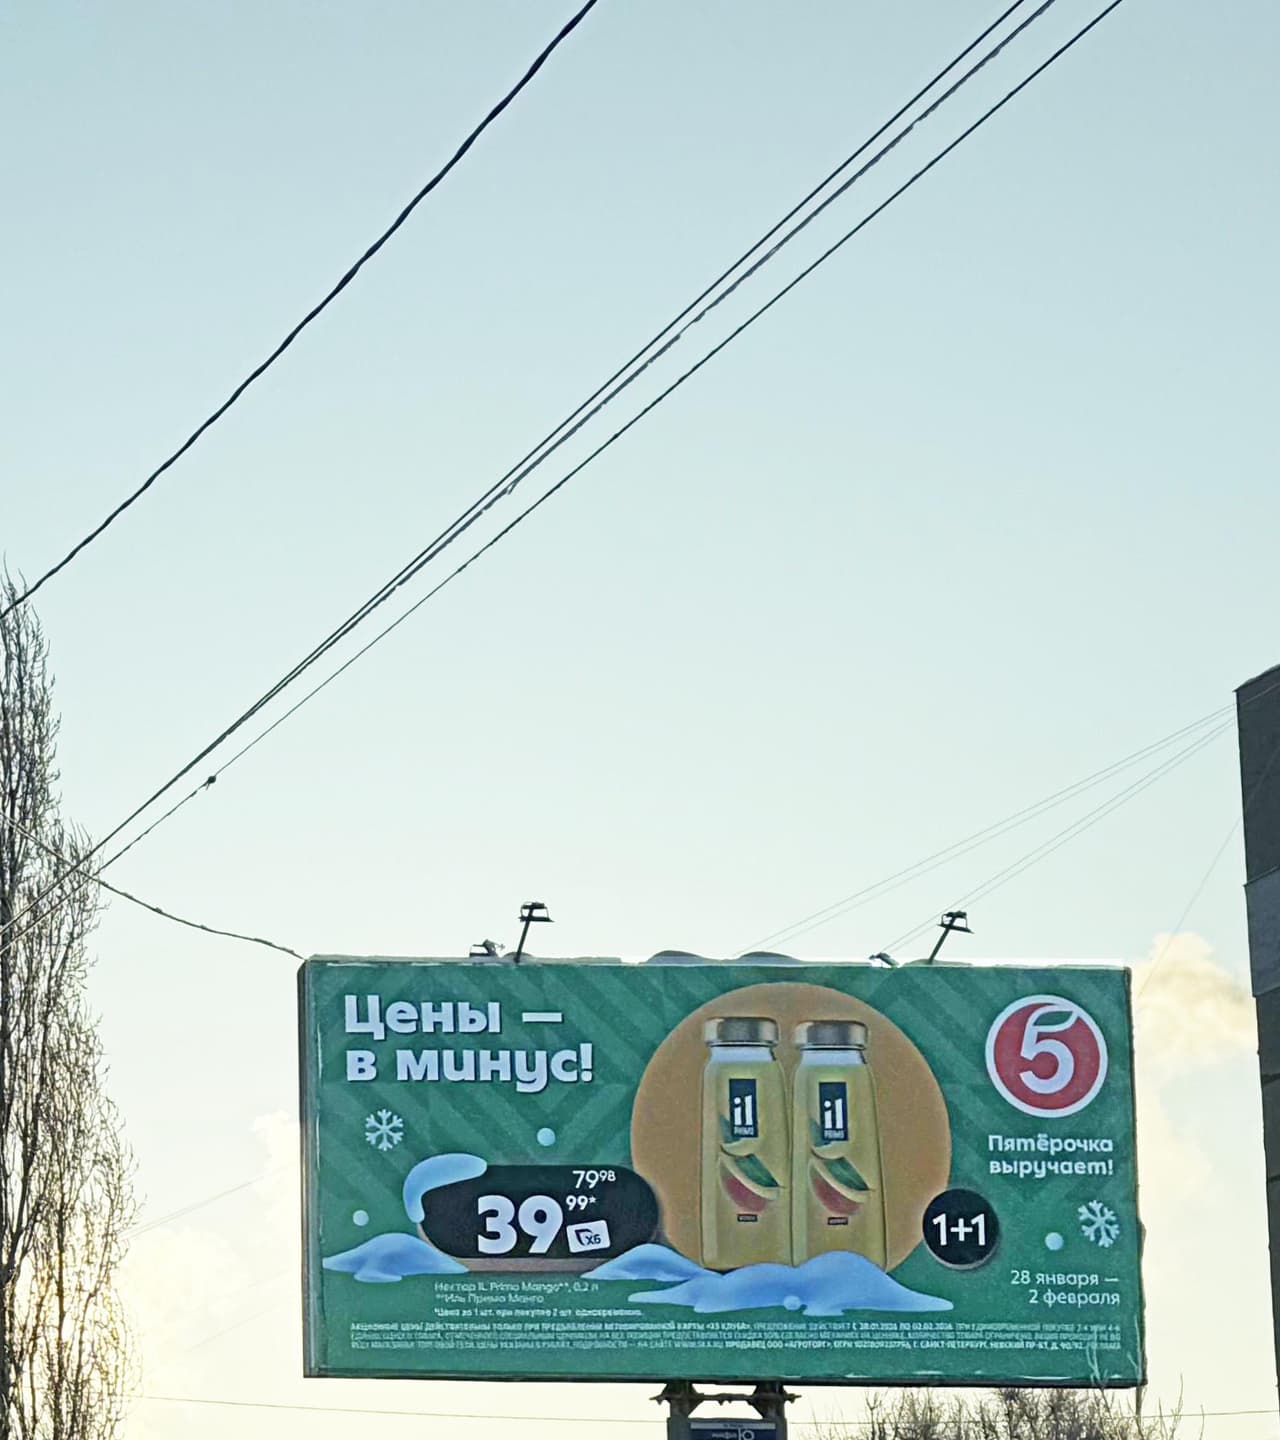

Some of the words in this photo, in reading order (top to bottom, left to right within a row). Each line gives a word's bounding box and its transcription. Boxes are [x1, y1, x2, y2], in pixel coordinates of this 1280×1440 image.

[344, 994, 501, 1041] Цены
[346, 1049, 378, 1082] в
[395, 1042, 594, 1094] минус!
[987, 1133, 1114, 1156] Пятёрочка
[989, 1158, 1114, 1179] выручает!
[932, 1212, 986, 1247] 1+1
[1010, 1269, 1031, 1286] 28
[1035, 1273, 1100, 1289] января
[1028, 1289, 1039, 1304] 2
[1042, 1288, 1121, 1308] февраля
